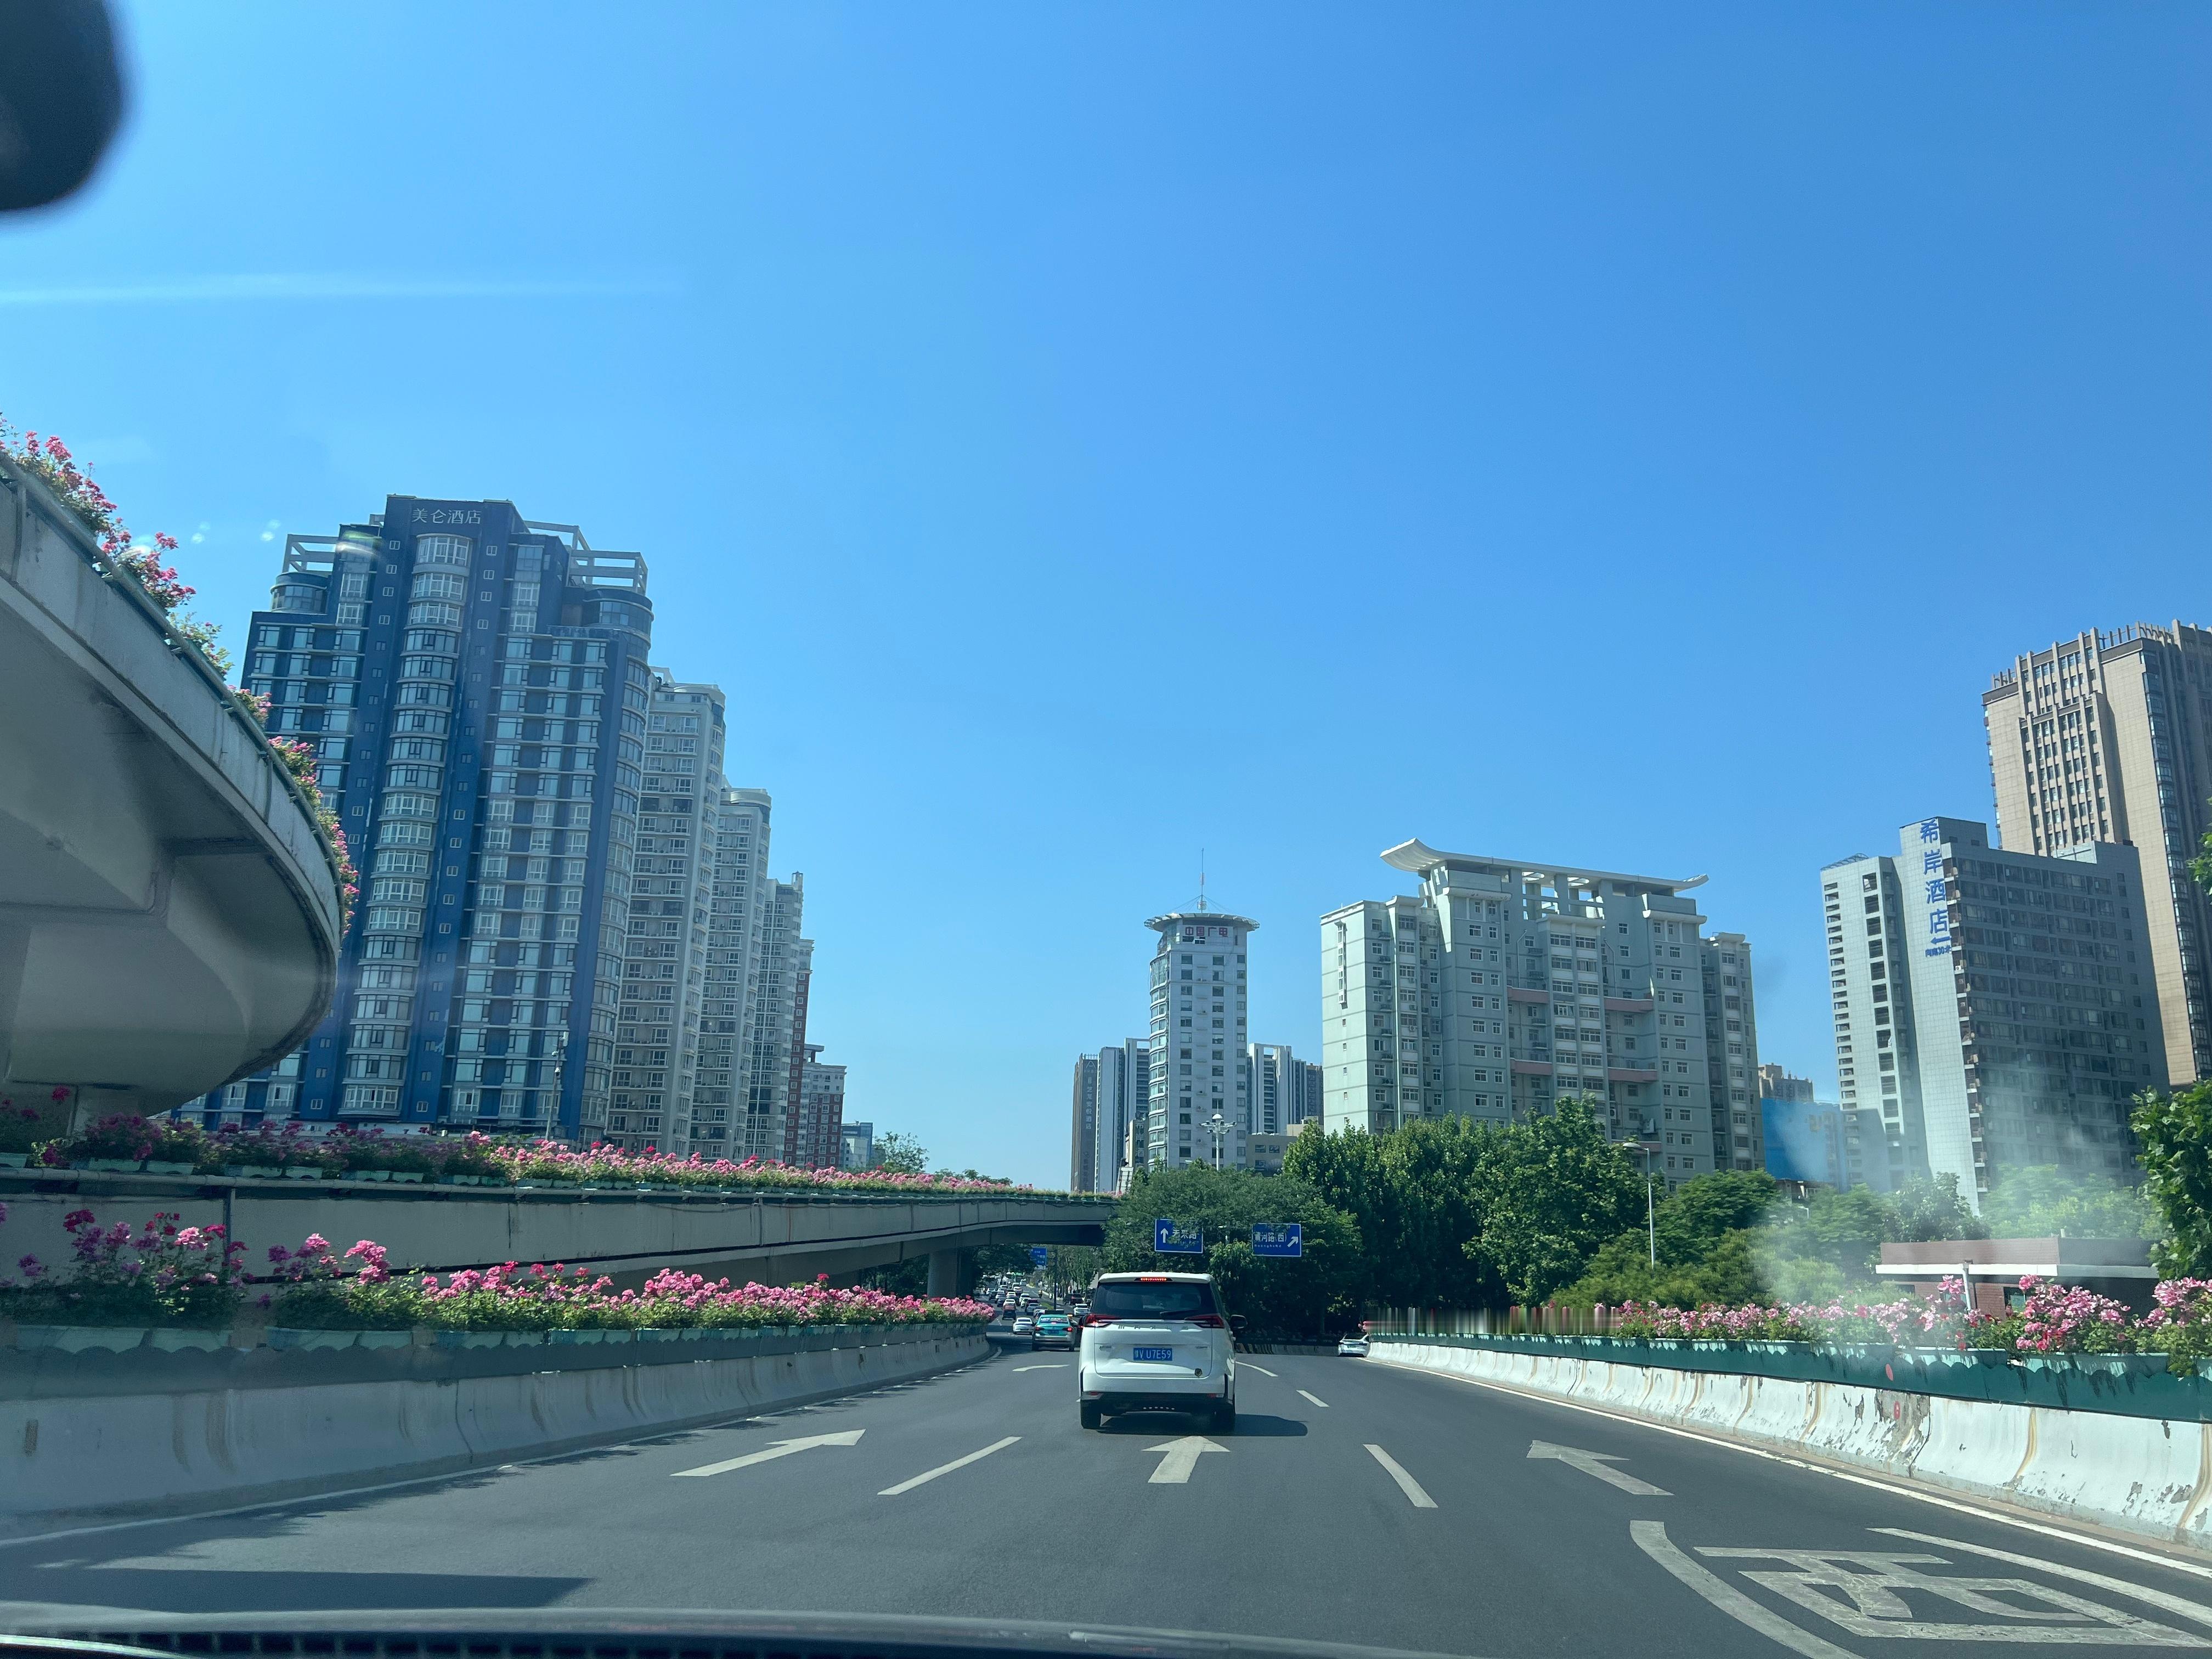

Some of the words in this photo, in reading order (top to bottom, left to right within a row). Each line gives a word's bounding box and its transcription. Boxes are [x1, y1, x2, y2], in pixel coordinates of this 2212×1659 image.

[412, 508, 481, 524] 美仑酒店
[1920, 819, 1948, 933] 希岸酒店
[1186, 926, 1228, 937] 中国广电
